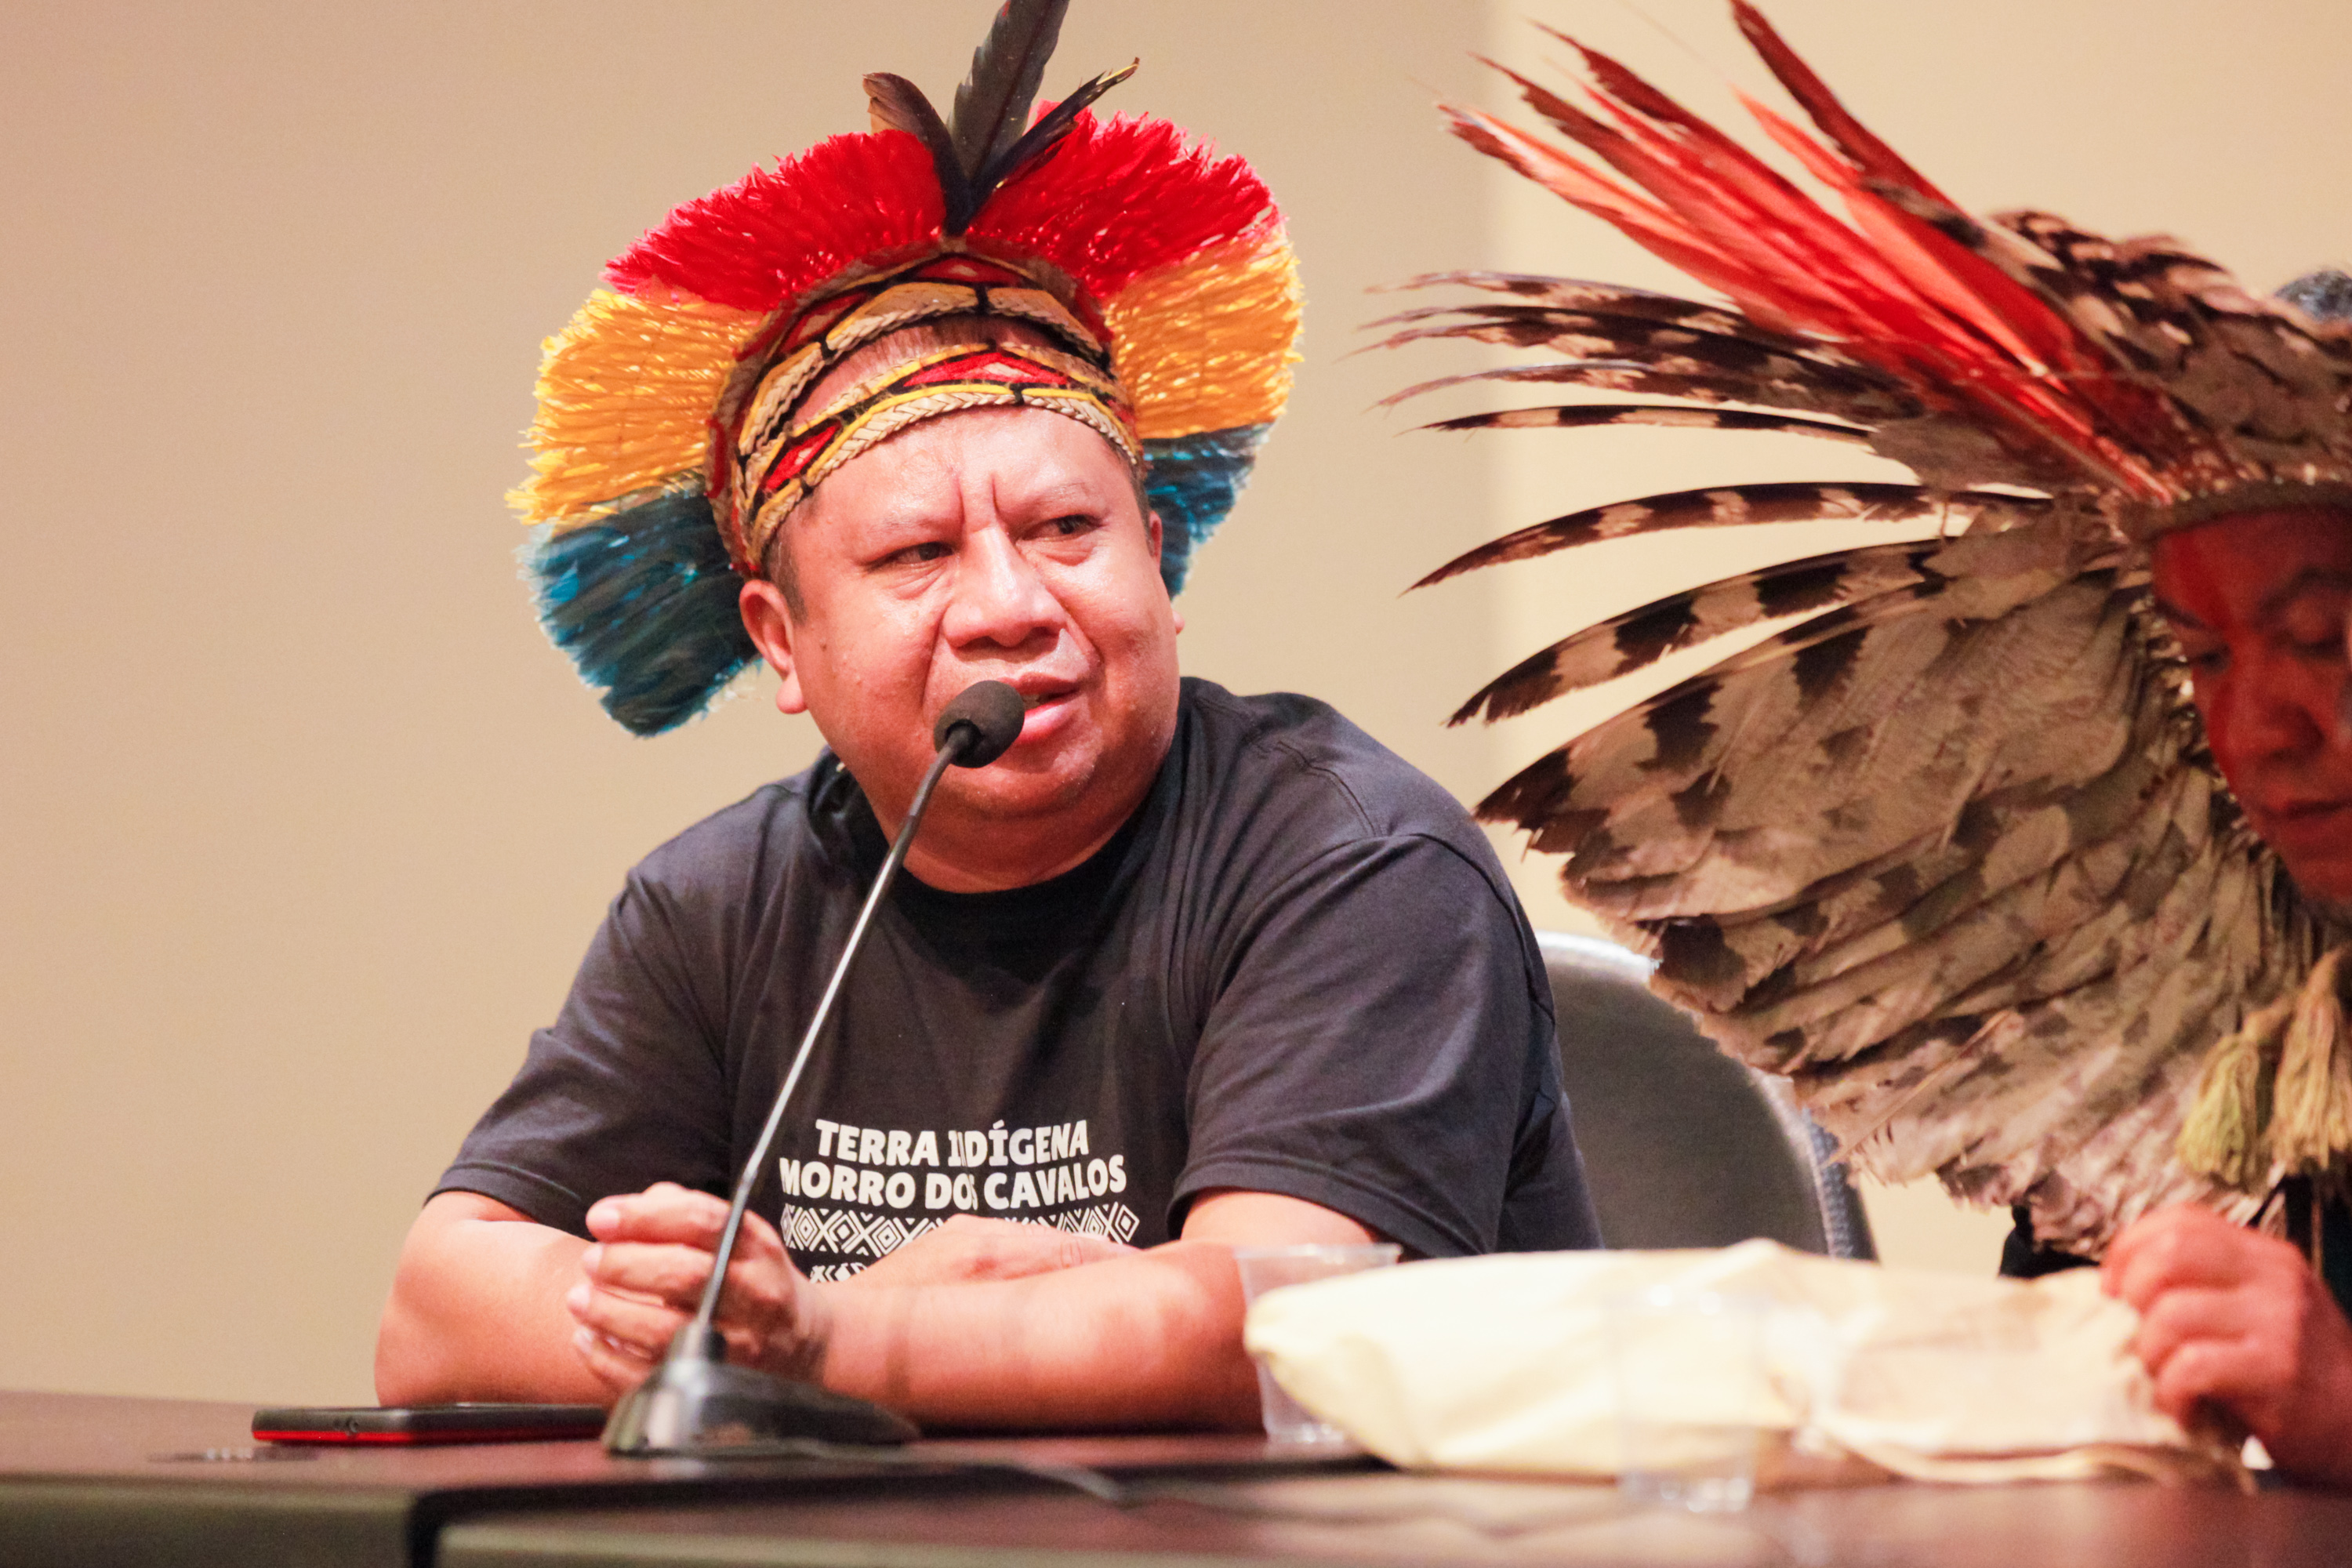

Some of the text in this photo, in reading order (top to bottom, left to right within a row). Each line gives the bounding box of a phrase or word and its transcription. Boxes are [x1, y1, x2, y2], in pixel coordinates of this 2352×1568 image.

[815, 1119, 940, 1167] TERRA
[779, 1157, 916, 1209] MORRO
[983, 1154, 1127, 1210] CAVALOS
